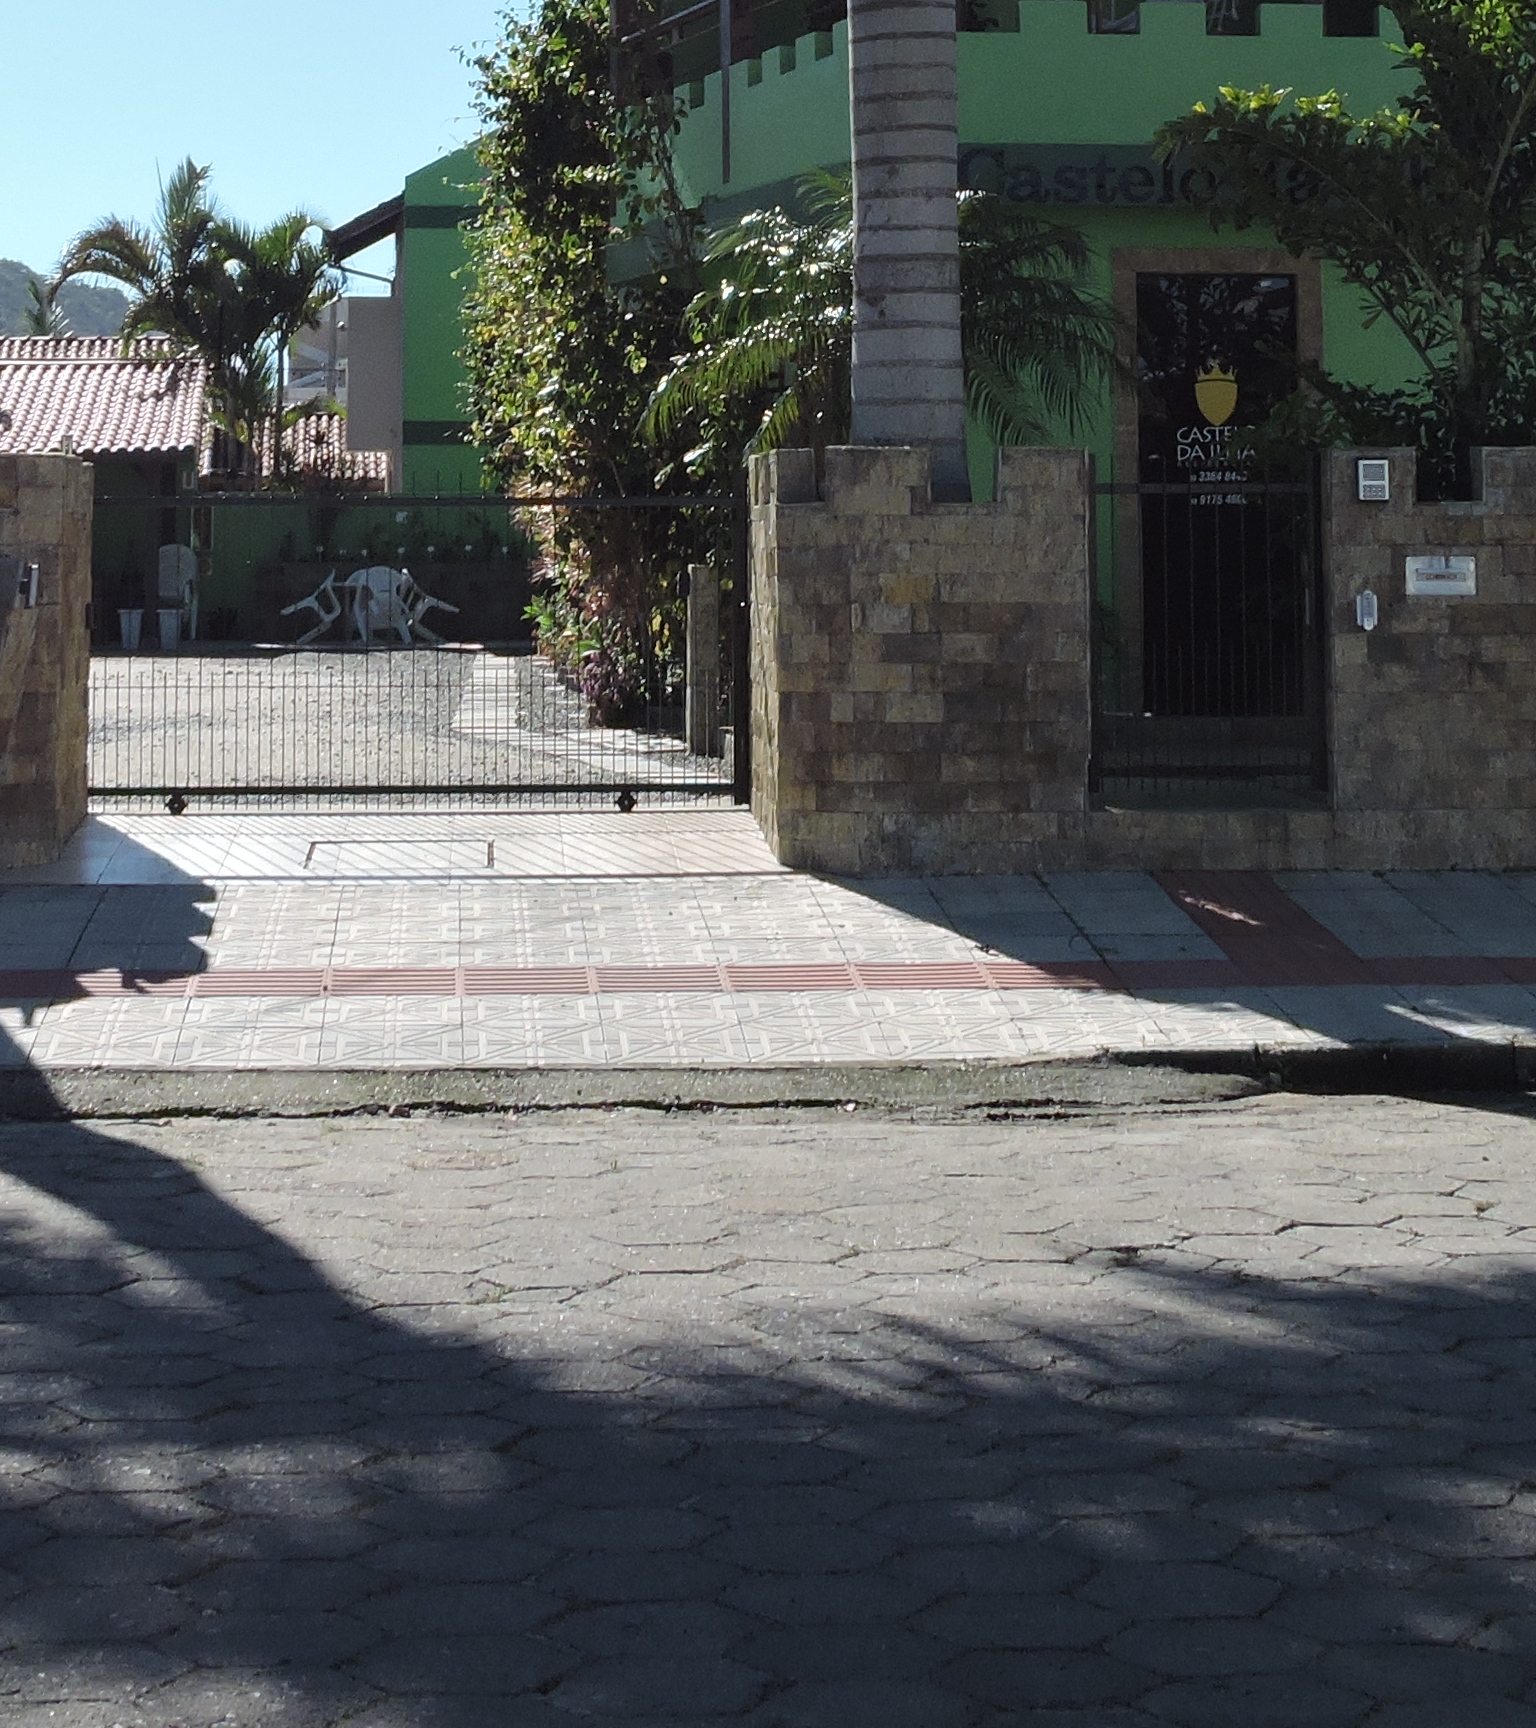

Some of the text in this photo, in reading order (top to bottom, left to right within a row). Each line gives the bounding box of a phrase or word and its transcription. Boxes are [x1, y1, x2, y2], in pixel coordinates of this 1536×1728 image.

[958, 147, 1218, 204] Castelo
[1176, 425, 1256, 443] CASTE
[1176, 444, 1205, 461] DA
